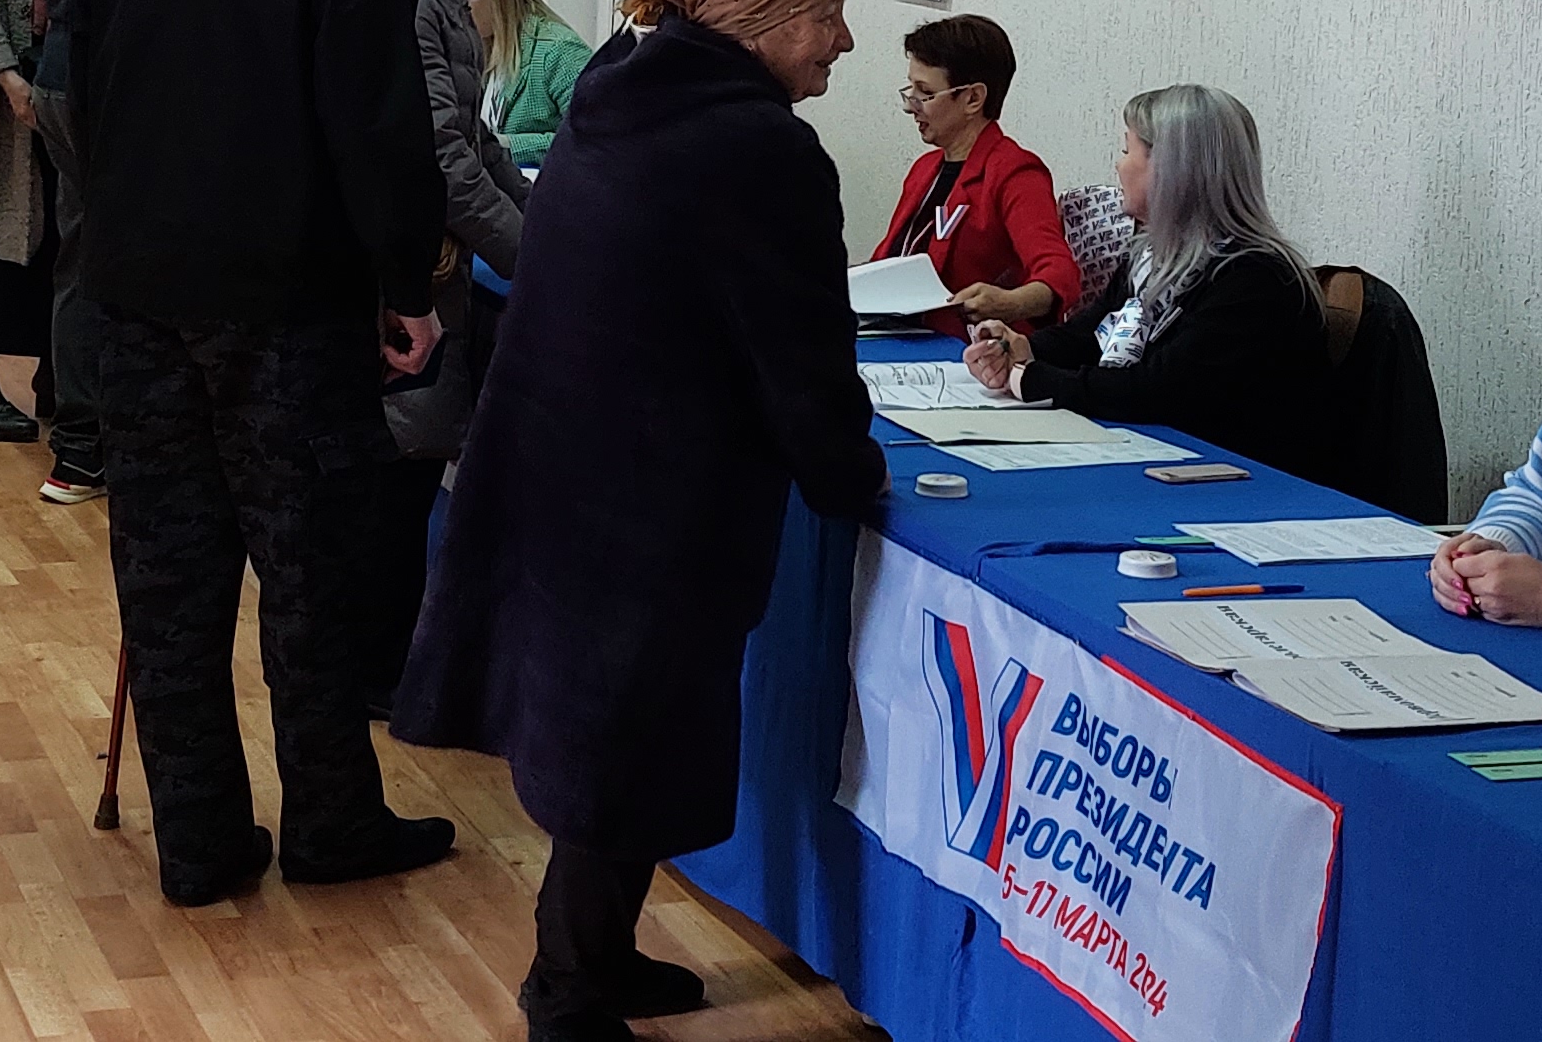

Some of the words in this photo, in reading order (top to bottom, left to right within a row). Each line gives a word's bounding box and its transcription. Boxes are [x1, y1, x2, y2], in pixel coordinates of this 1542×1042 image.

[1050, 691, 1179, 811] ВЫБОРЫ
[1006, 804, 1132, 917] РОССИИ
[1002, 862, 1058, 919] 5–17
[1053, 894, 1129, 979] МАРТА
